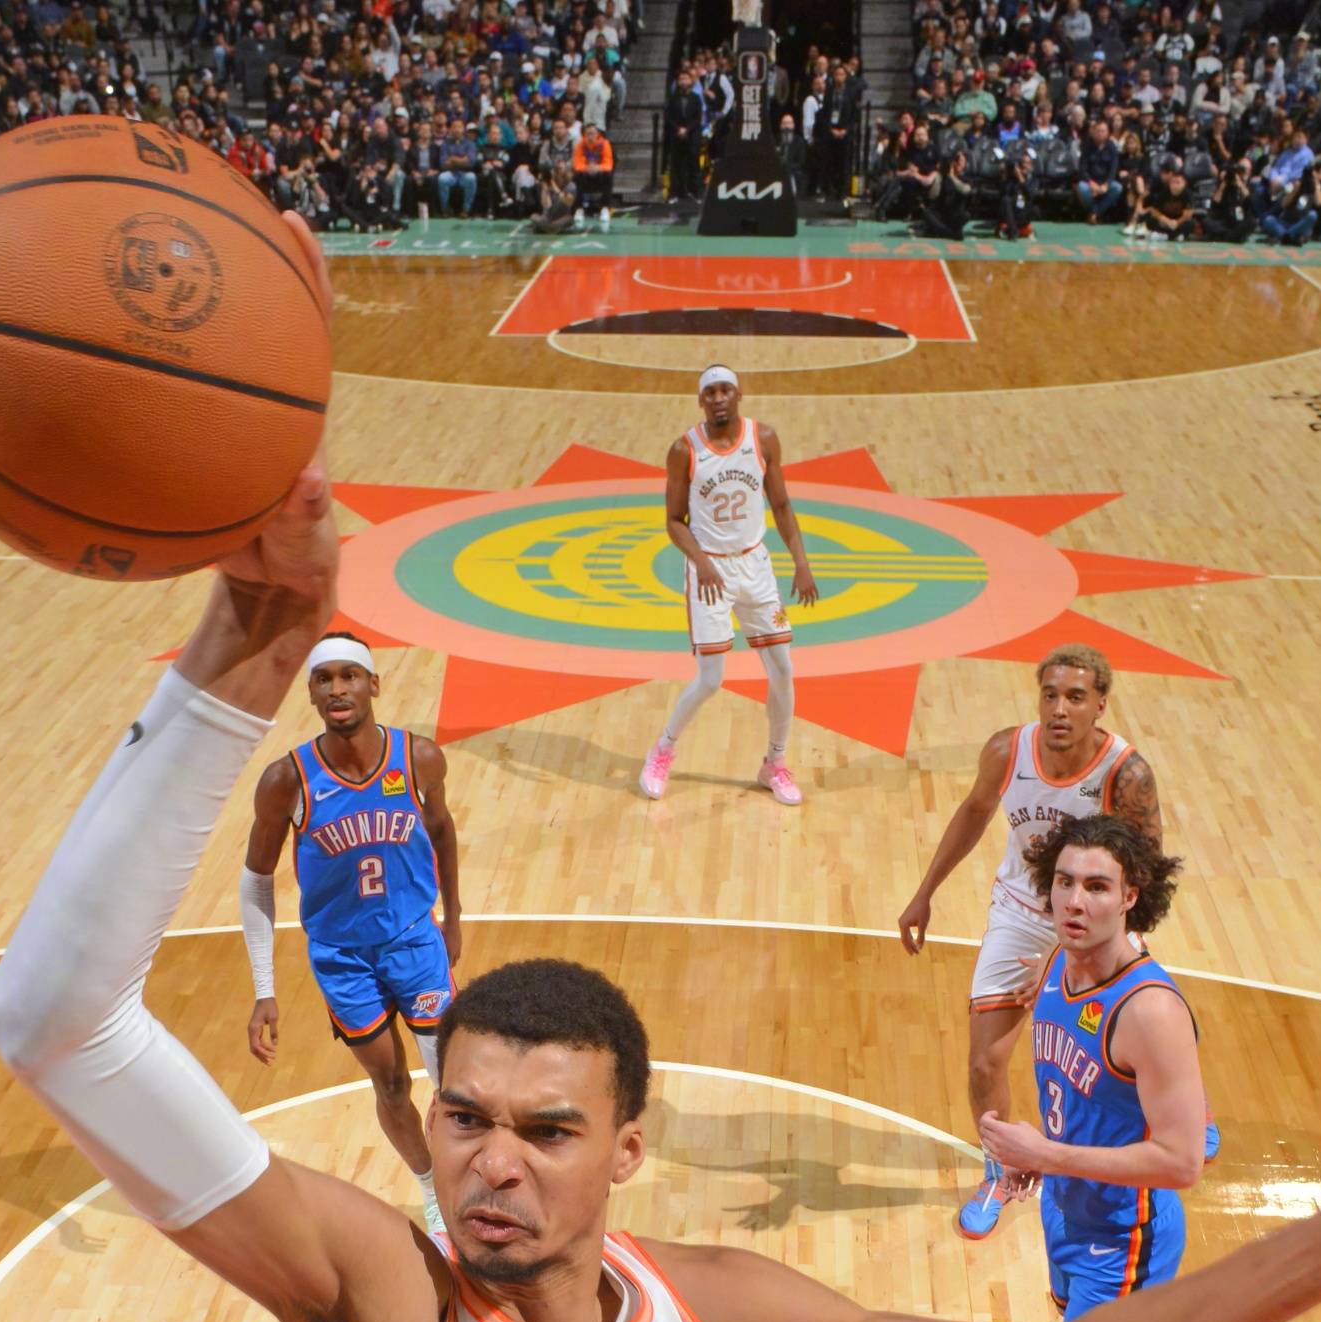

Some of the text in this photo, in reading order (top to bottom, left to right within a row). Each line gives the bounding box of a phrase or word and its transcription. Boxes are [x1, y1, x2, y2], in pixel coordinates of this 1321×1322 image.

[742, 84, 762, 102] GET
[742, 104, 762, 121] THE
[699, 470, 760, 499] SAN ANTONIO
[712, 489, 748, 523] 22
[1079, 786, 1102, 799] Self.
[310, 808, 417, 857] THUNDER
[358, 854, 386, 898] 2
[1046, 1079, 1065, 1139] 3
